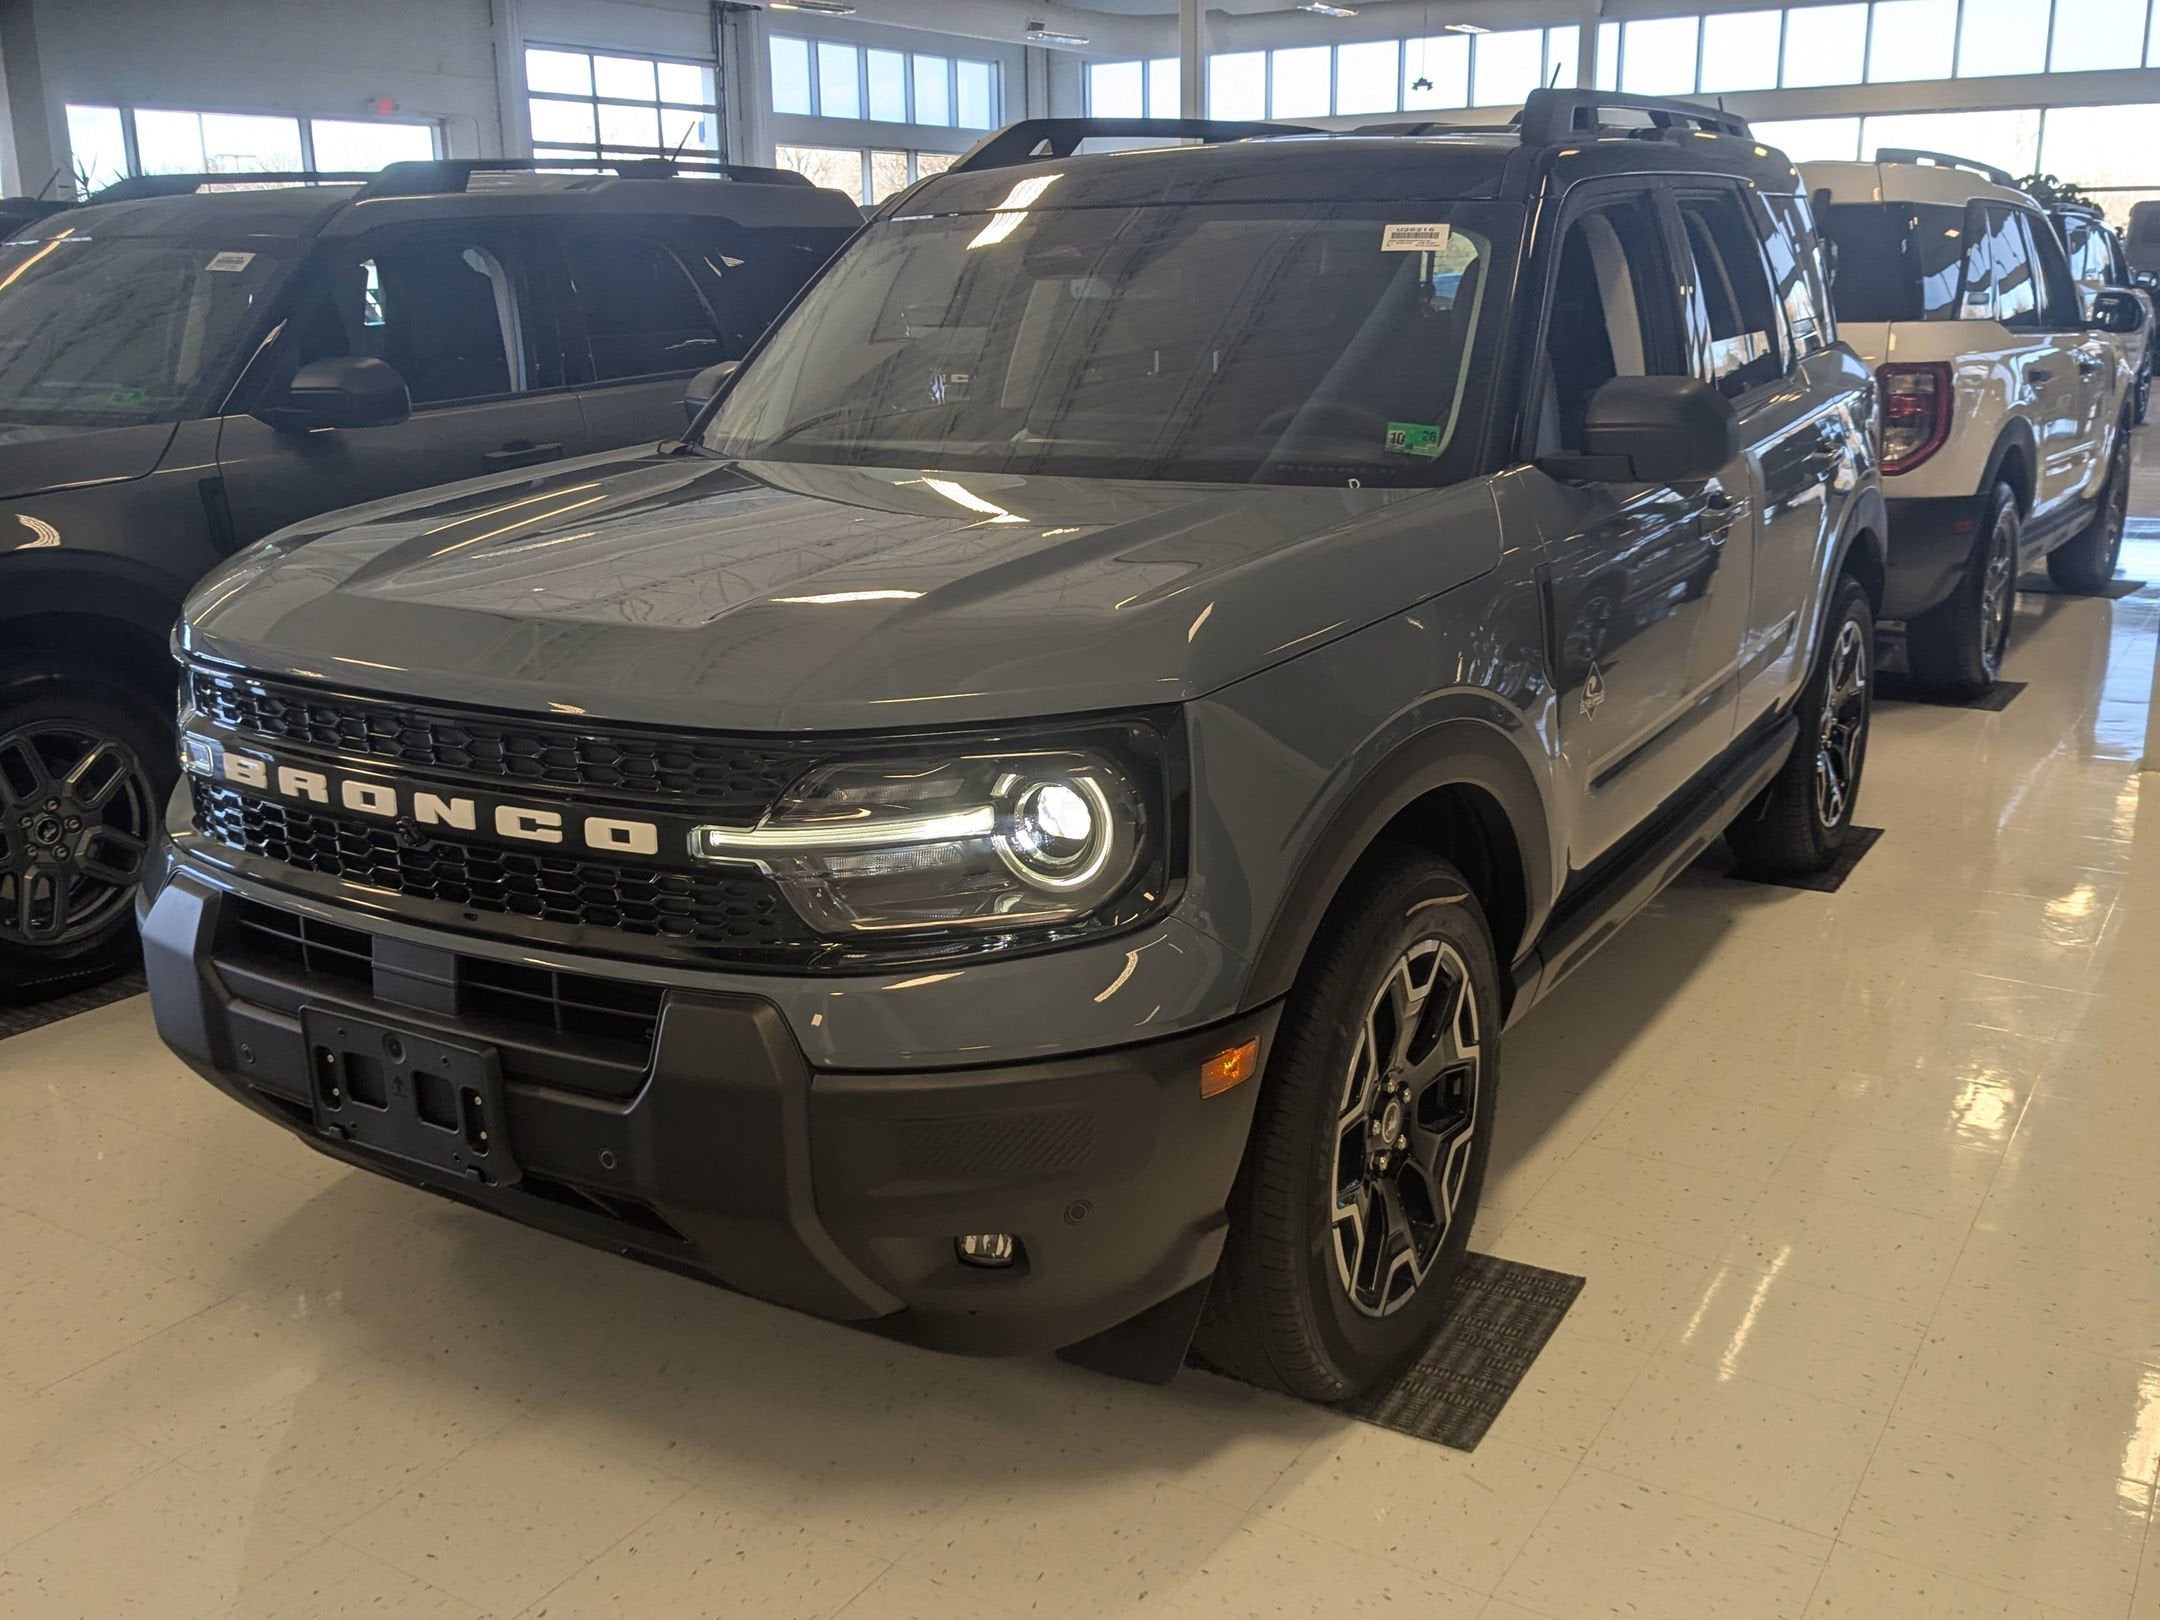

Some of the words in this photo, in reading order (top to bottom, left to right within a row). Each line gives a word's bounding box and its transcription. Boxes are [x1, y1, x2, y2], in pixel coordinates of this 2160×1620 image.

[1390, 431, 1405, 445] 10
[1422, 430, 1437, 442] 26
[223, 752, 658, 855] BRONCO
